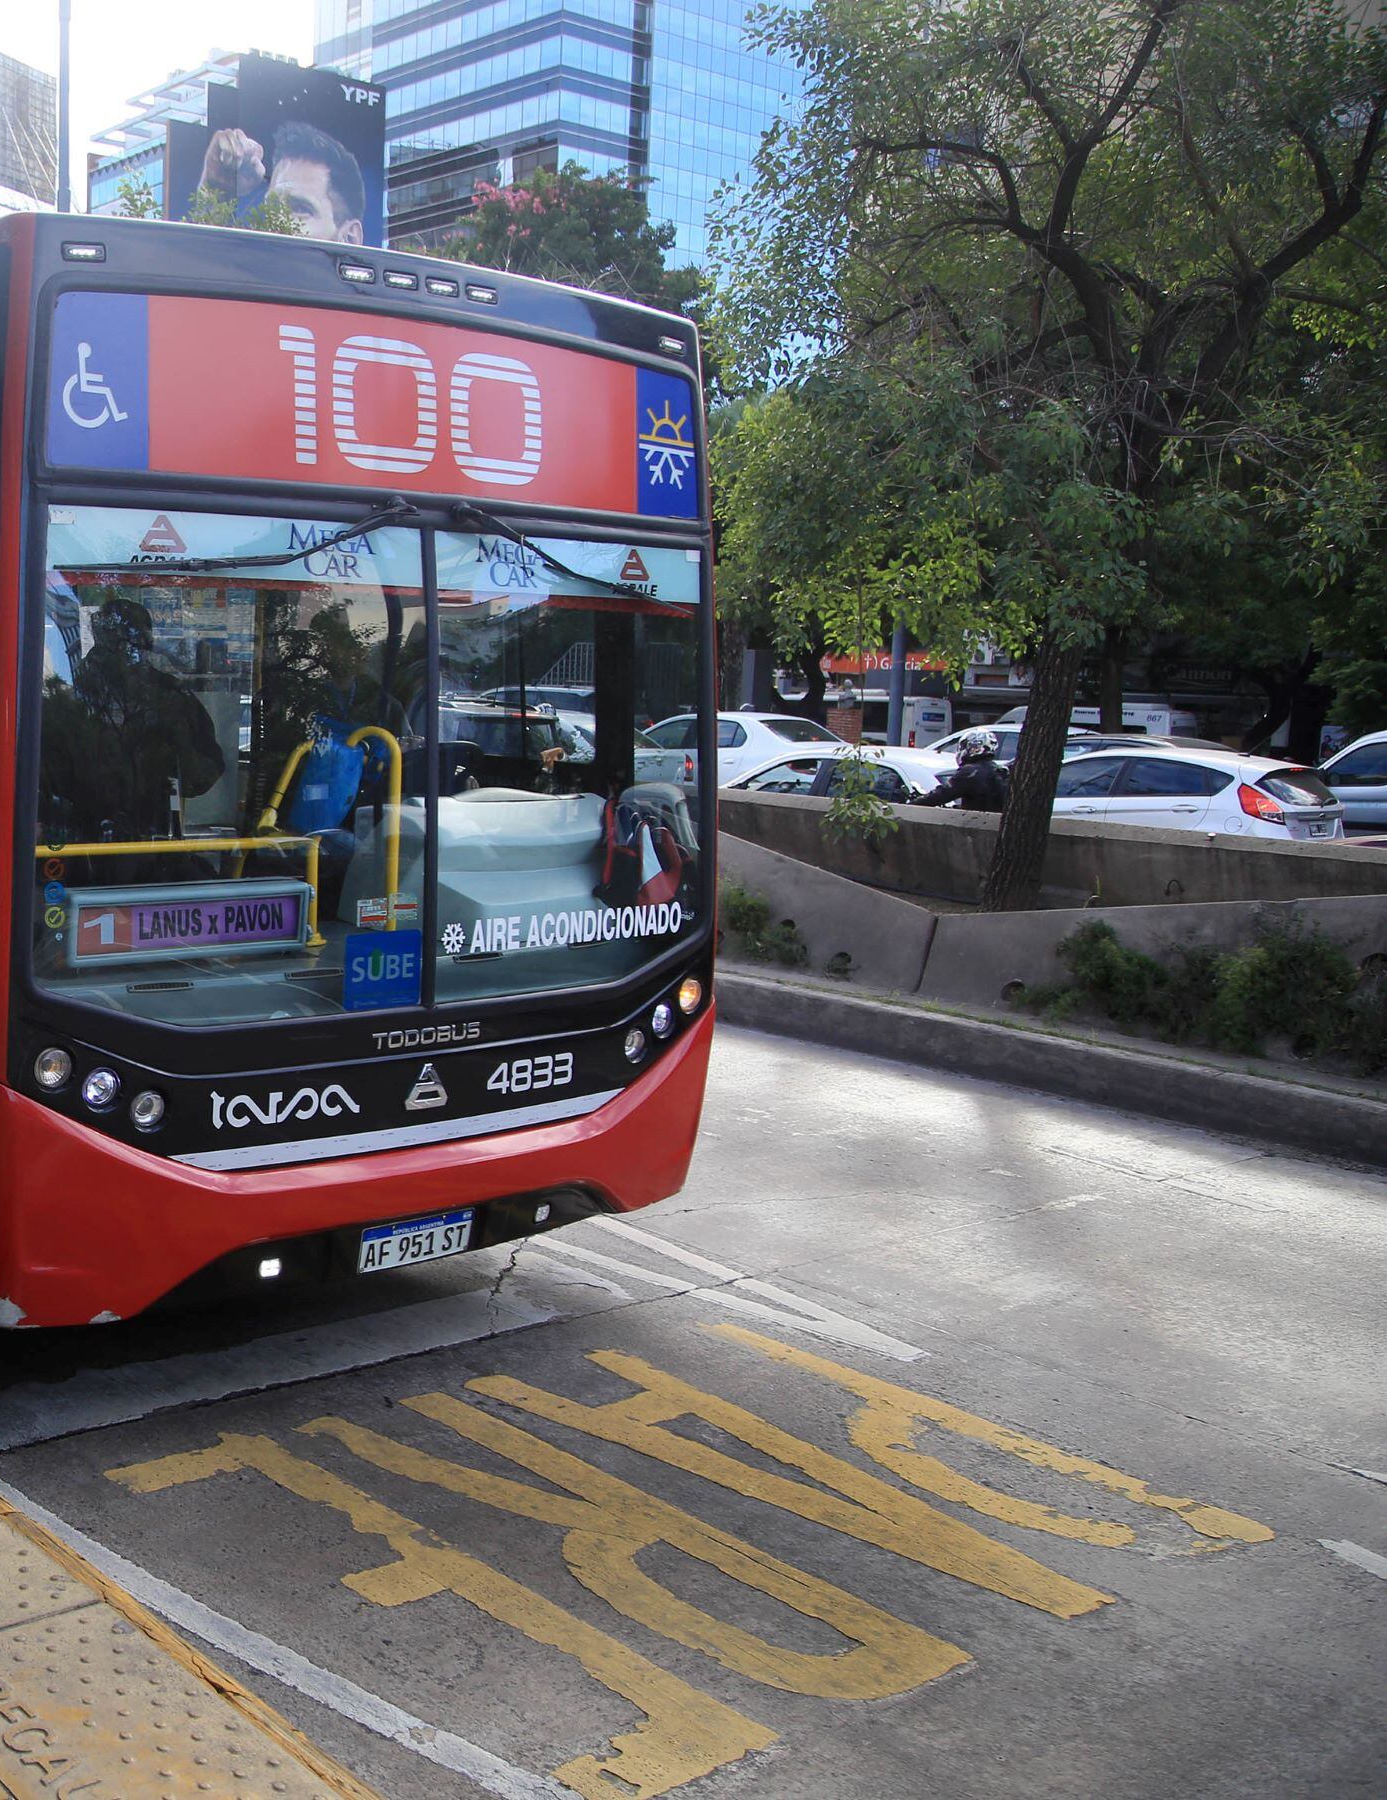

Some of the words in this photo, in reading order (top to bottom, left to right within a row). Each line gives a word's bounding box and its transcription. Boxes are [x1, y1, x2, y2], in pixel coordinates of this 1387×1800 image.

[340, 84, 380, 106] YPF
[279, 325, 542, 486] 100
[303, 551, 362, 578] CAR
[490, 561, 537, 588] CAR
[83, 913, 114, 944] 1
[138, 907, 202, 940] LANUS
[224, 903, 284, 933] PAVON
[470, 916, 521, 953] AIRE
[526, 901, 681, 948] ACONDICIONADO
[352, 953, 415, 982] SUBE
[372, 1022, 481, 1050] TODOBUS
[487, 1052, 573, 1094] 4833
[364, 1239, 392, 1269] AF
[399, 1231, 434, 1262] 951
[442, 1224, 467, 1251] ST
